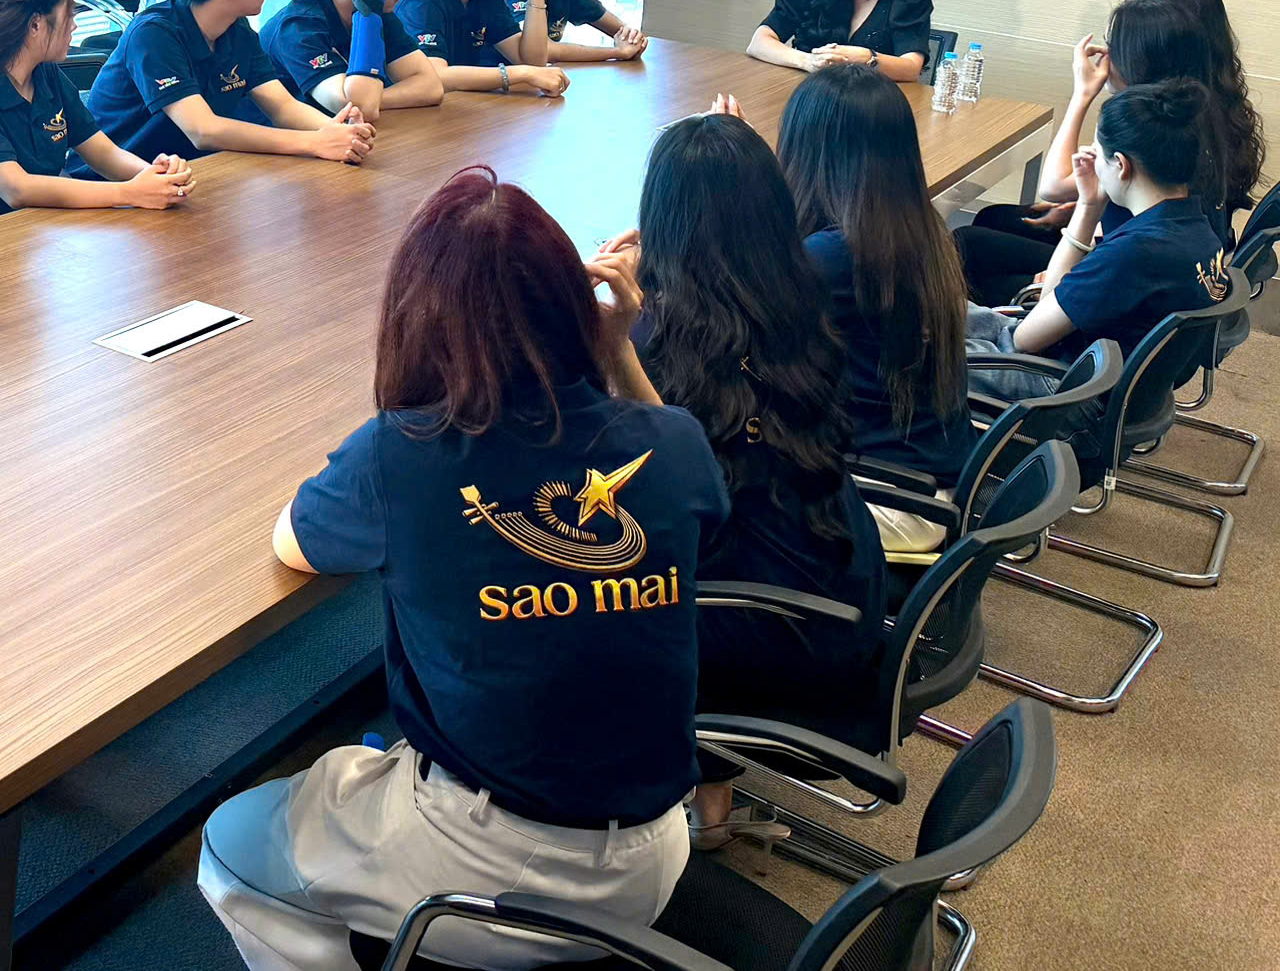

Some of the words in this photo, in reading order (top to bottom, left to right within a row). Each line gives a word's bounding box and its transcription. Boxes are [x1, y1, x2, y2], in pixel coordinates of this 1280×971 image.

[309, 52, 328, 67] VTV
[478, 581, 578, 621] sao
[590, 566, 680, 613] mai
